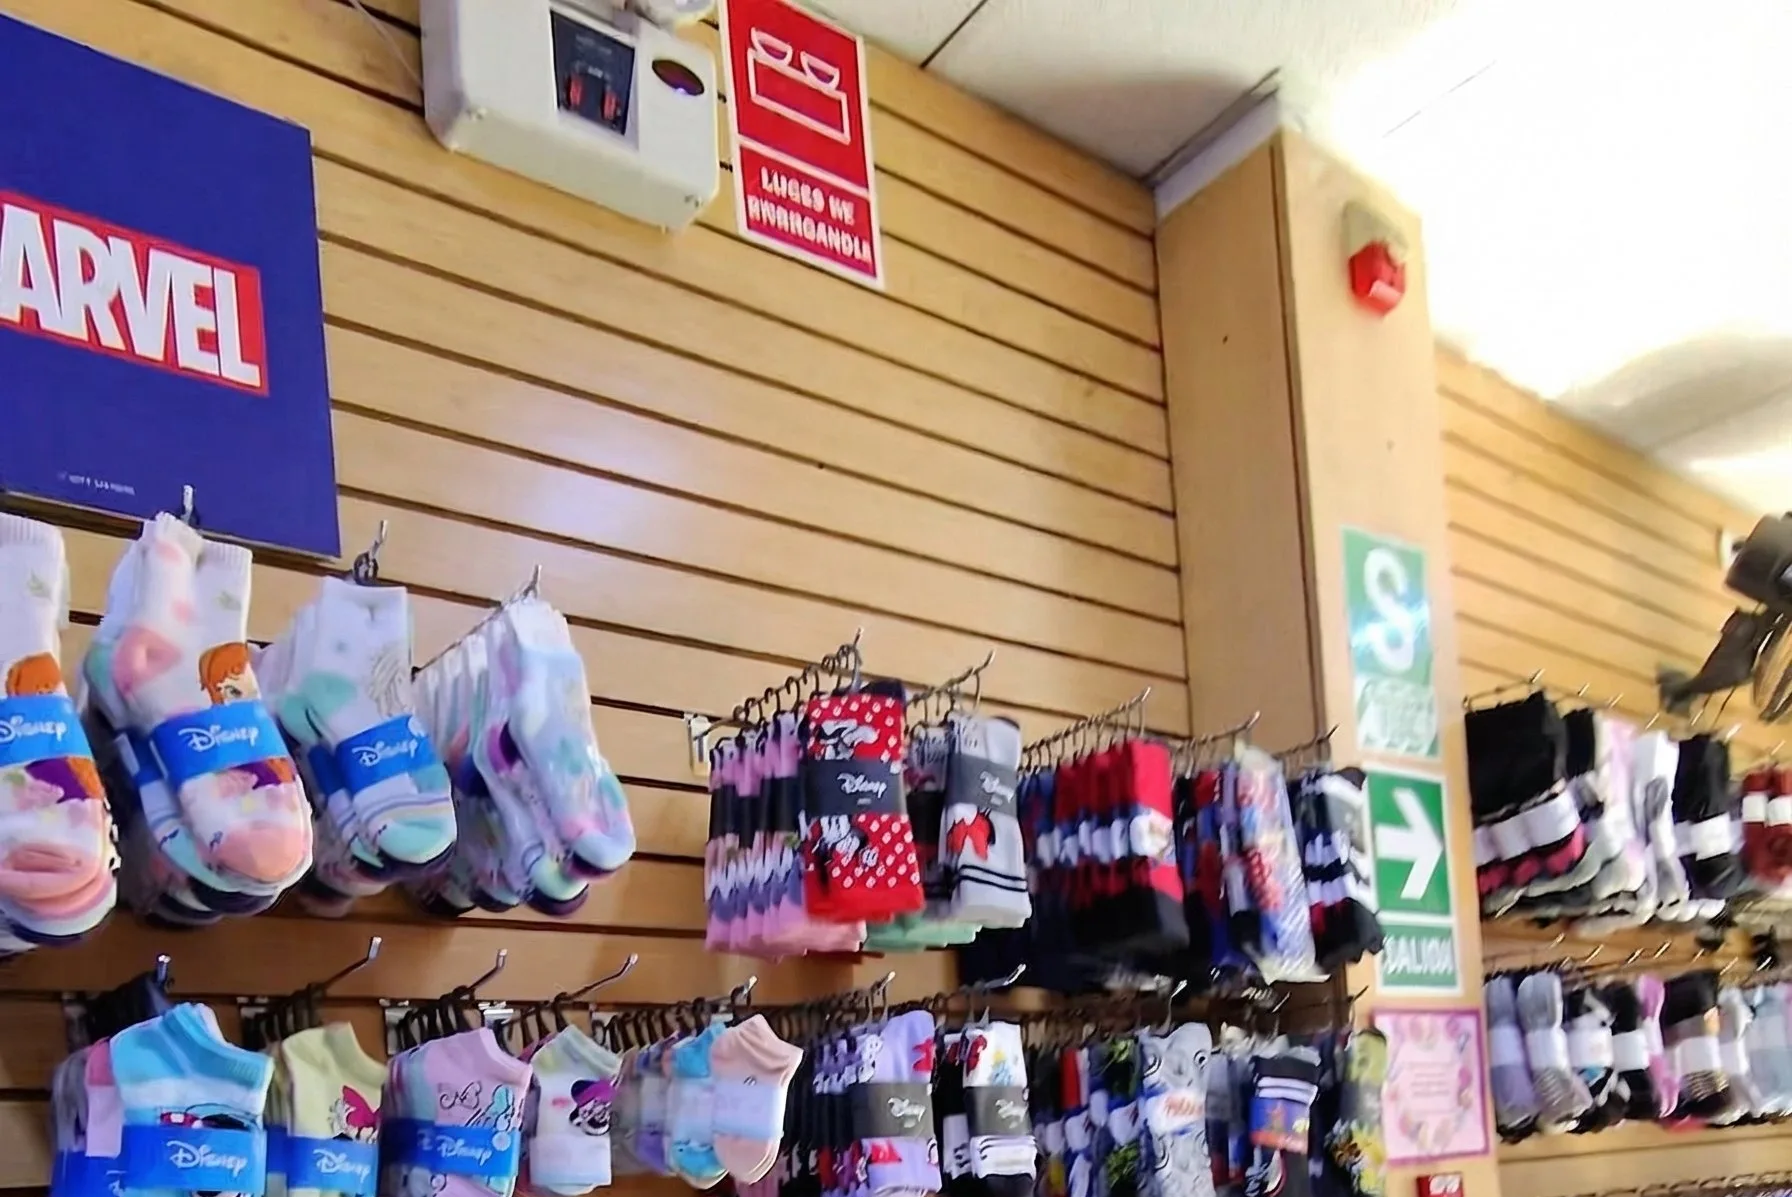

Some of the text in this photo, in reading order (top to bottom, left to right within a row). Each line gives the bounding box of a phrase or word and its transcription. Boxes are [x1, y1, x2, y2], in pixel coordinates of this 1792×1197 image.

[178, 724, 260, 751] Disney
[351, 739, 419, 767] Disney
[166, 1140, 248, 1178] Disney
[313, 1148, 371, 1183] Disney
[435, 1134, 493, 1167] Disney
